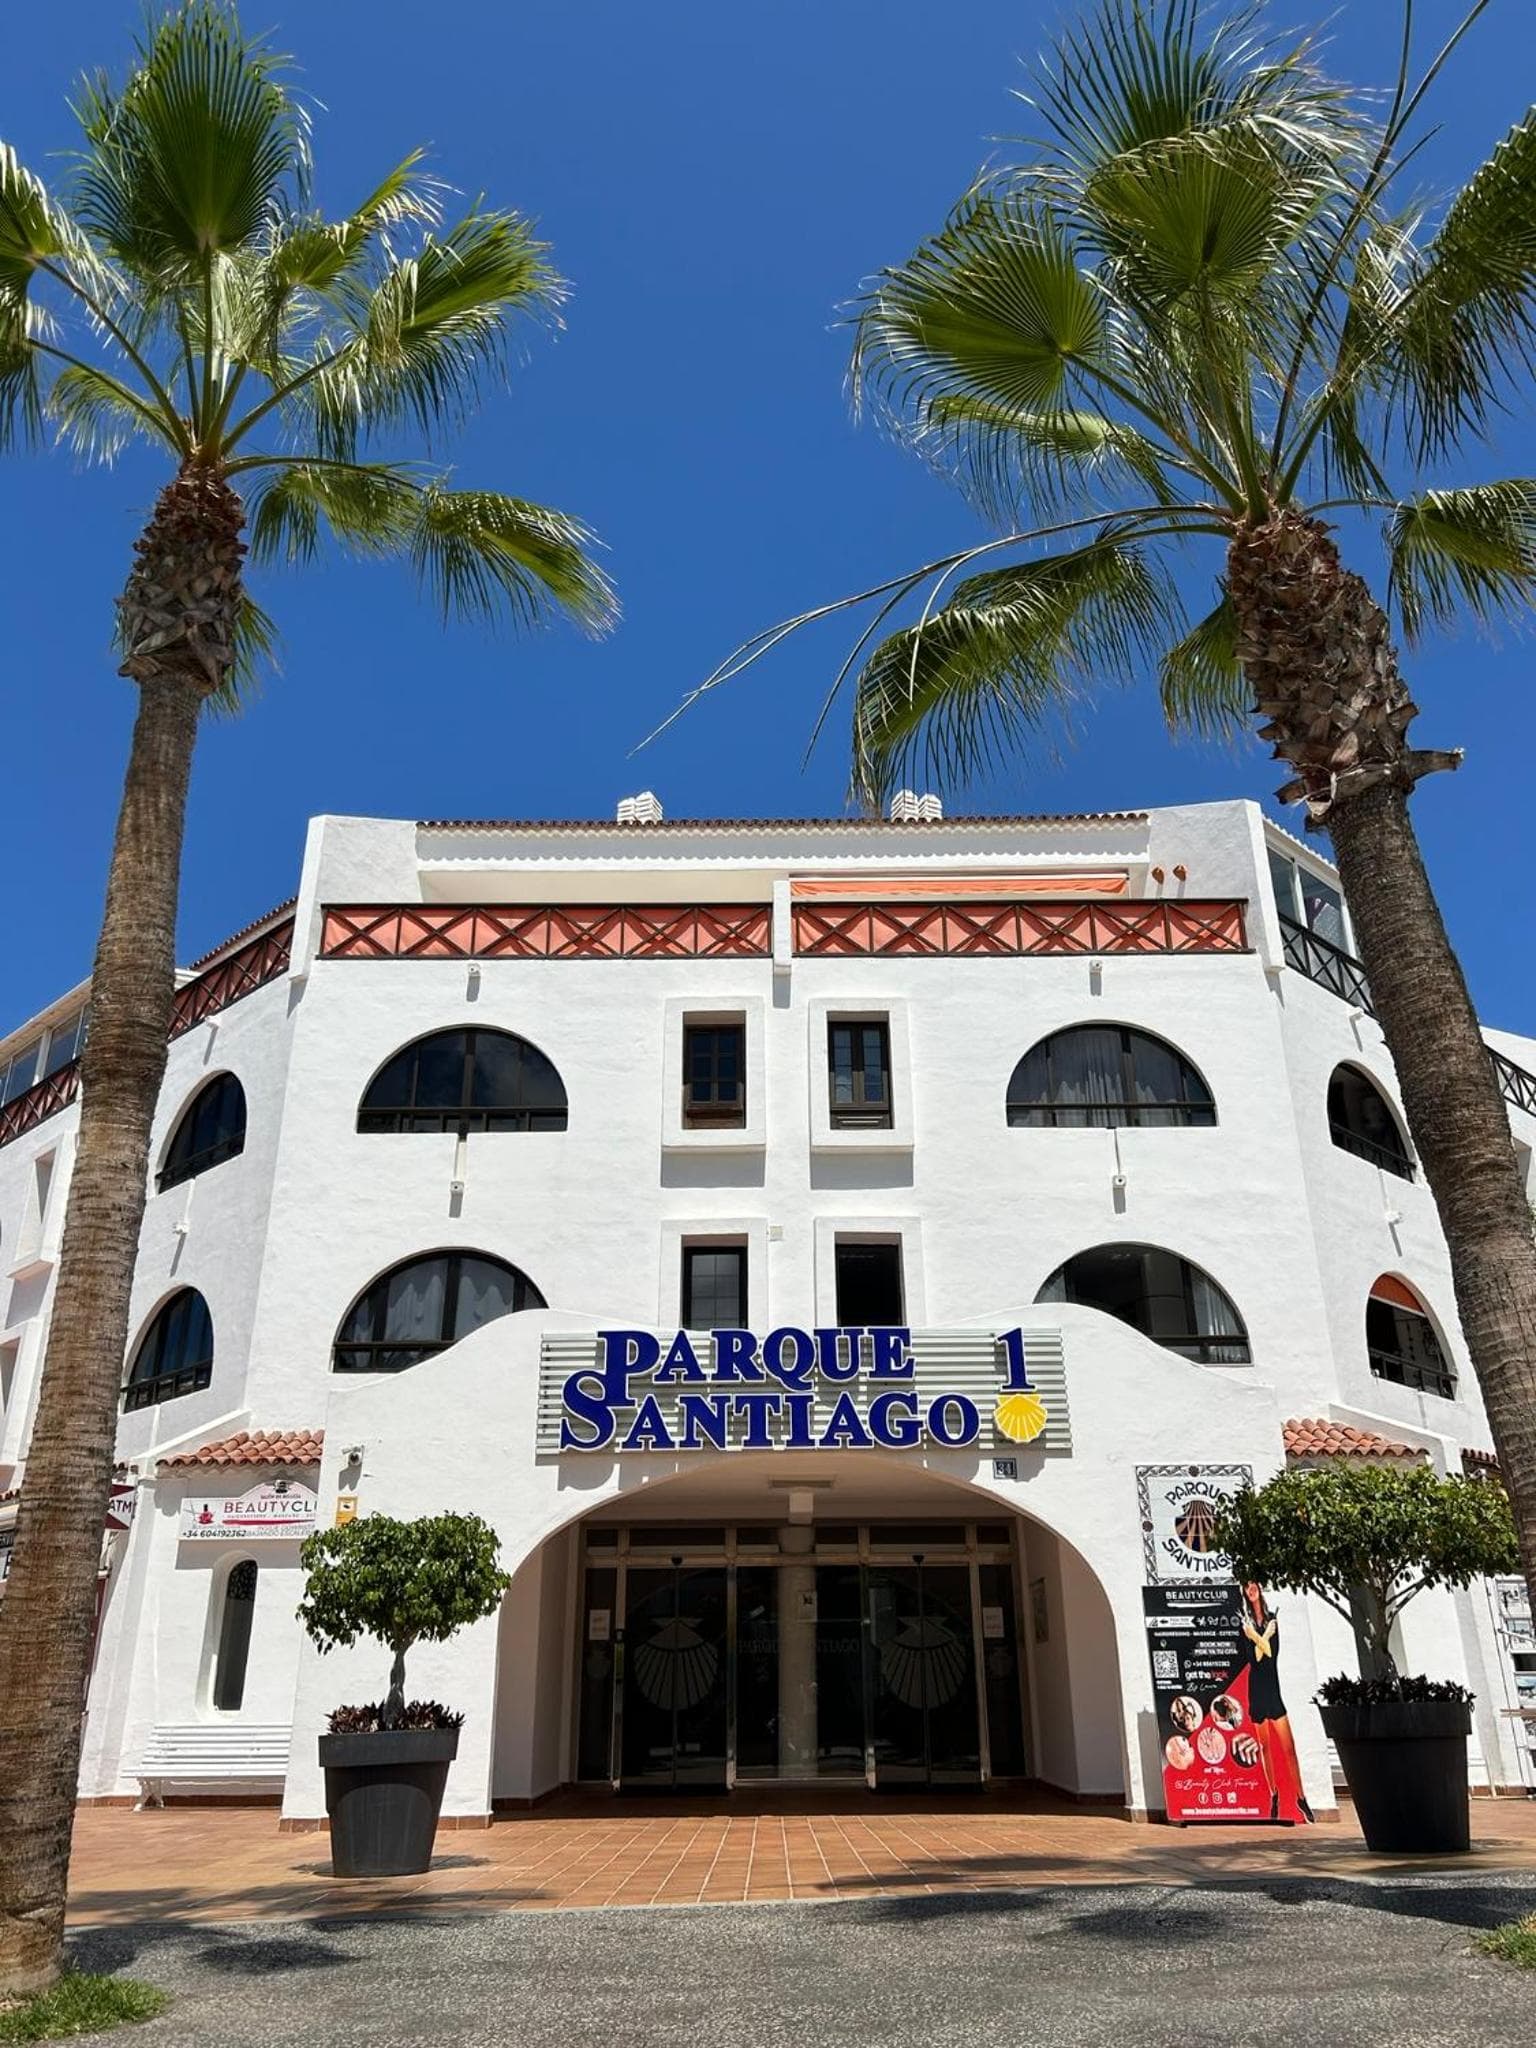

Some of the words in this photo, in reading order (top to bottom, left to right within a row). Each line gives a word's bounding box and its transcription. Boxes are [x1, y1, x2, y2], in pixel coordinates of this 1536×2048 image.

[597, 1327, 916, 1408] PARQUE
[997, 1326, 1037, 1392] 1
[560, 1369, 981, 1450] SANTIAGO
[109, 1499, 132, 1513] ATM
[1165, 1590, 1229, 1600] BEAUTYCLUB
